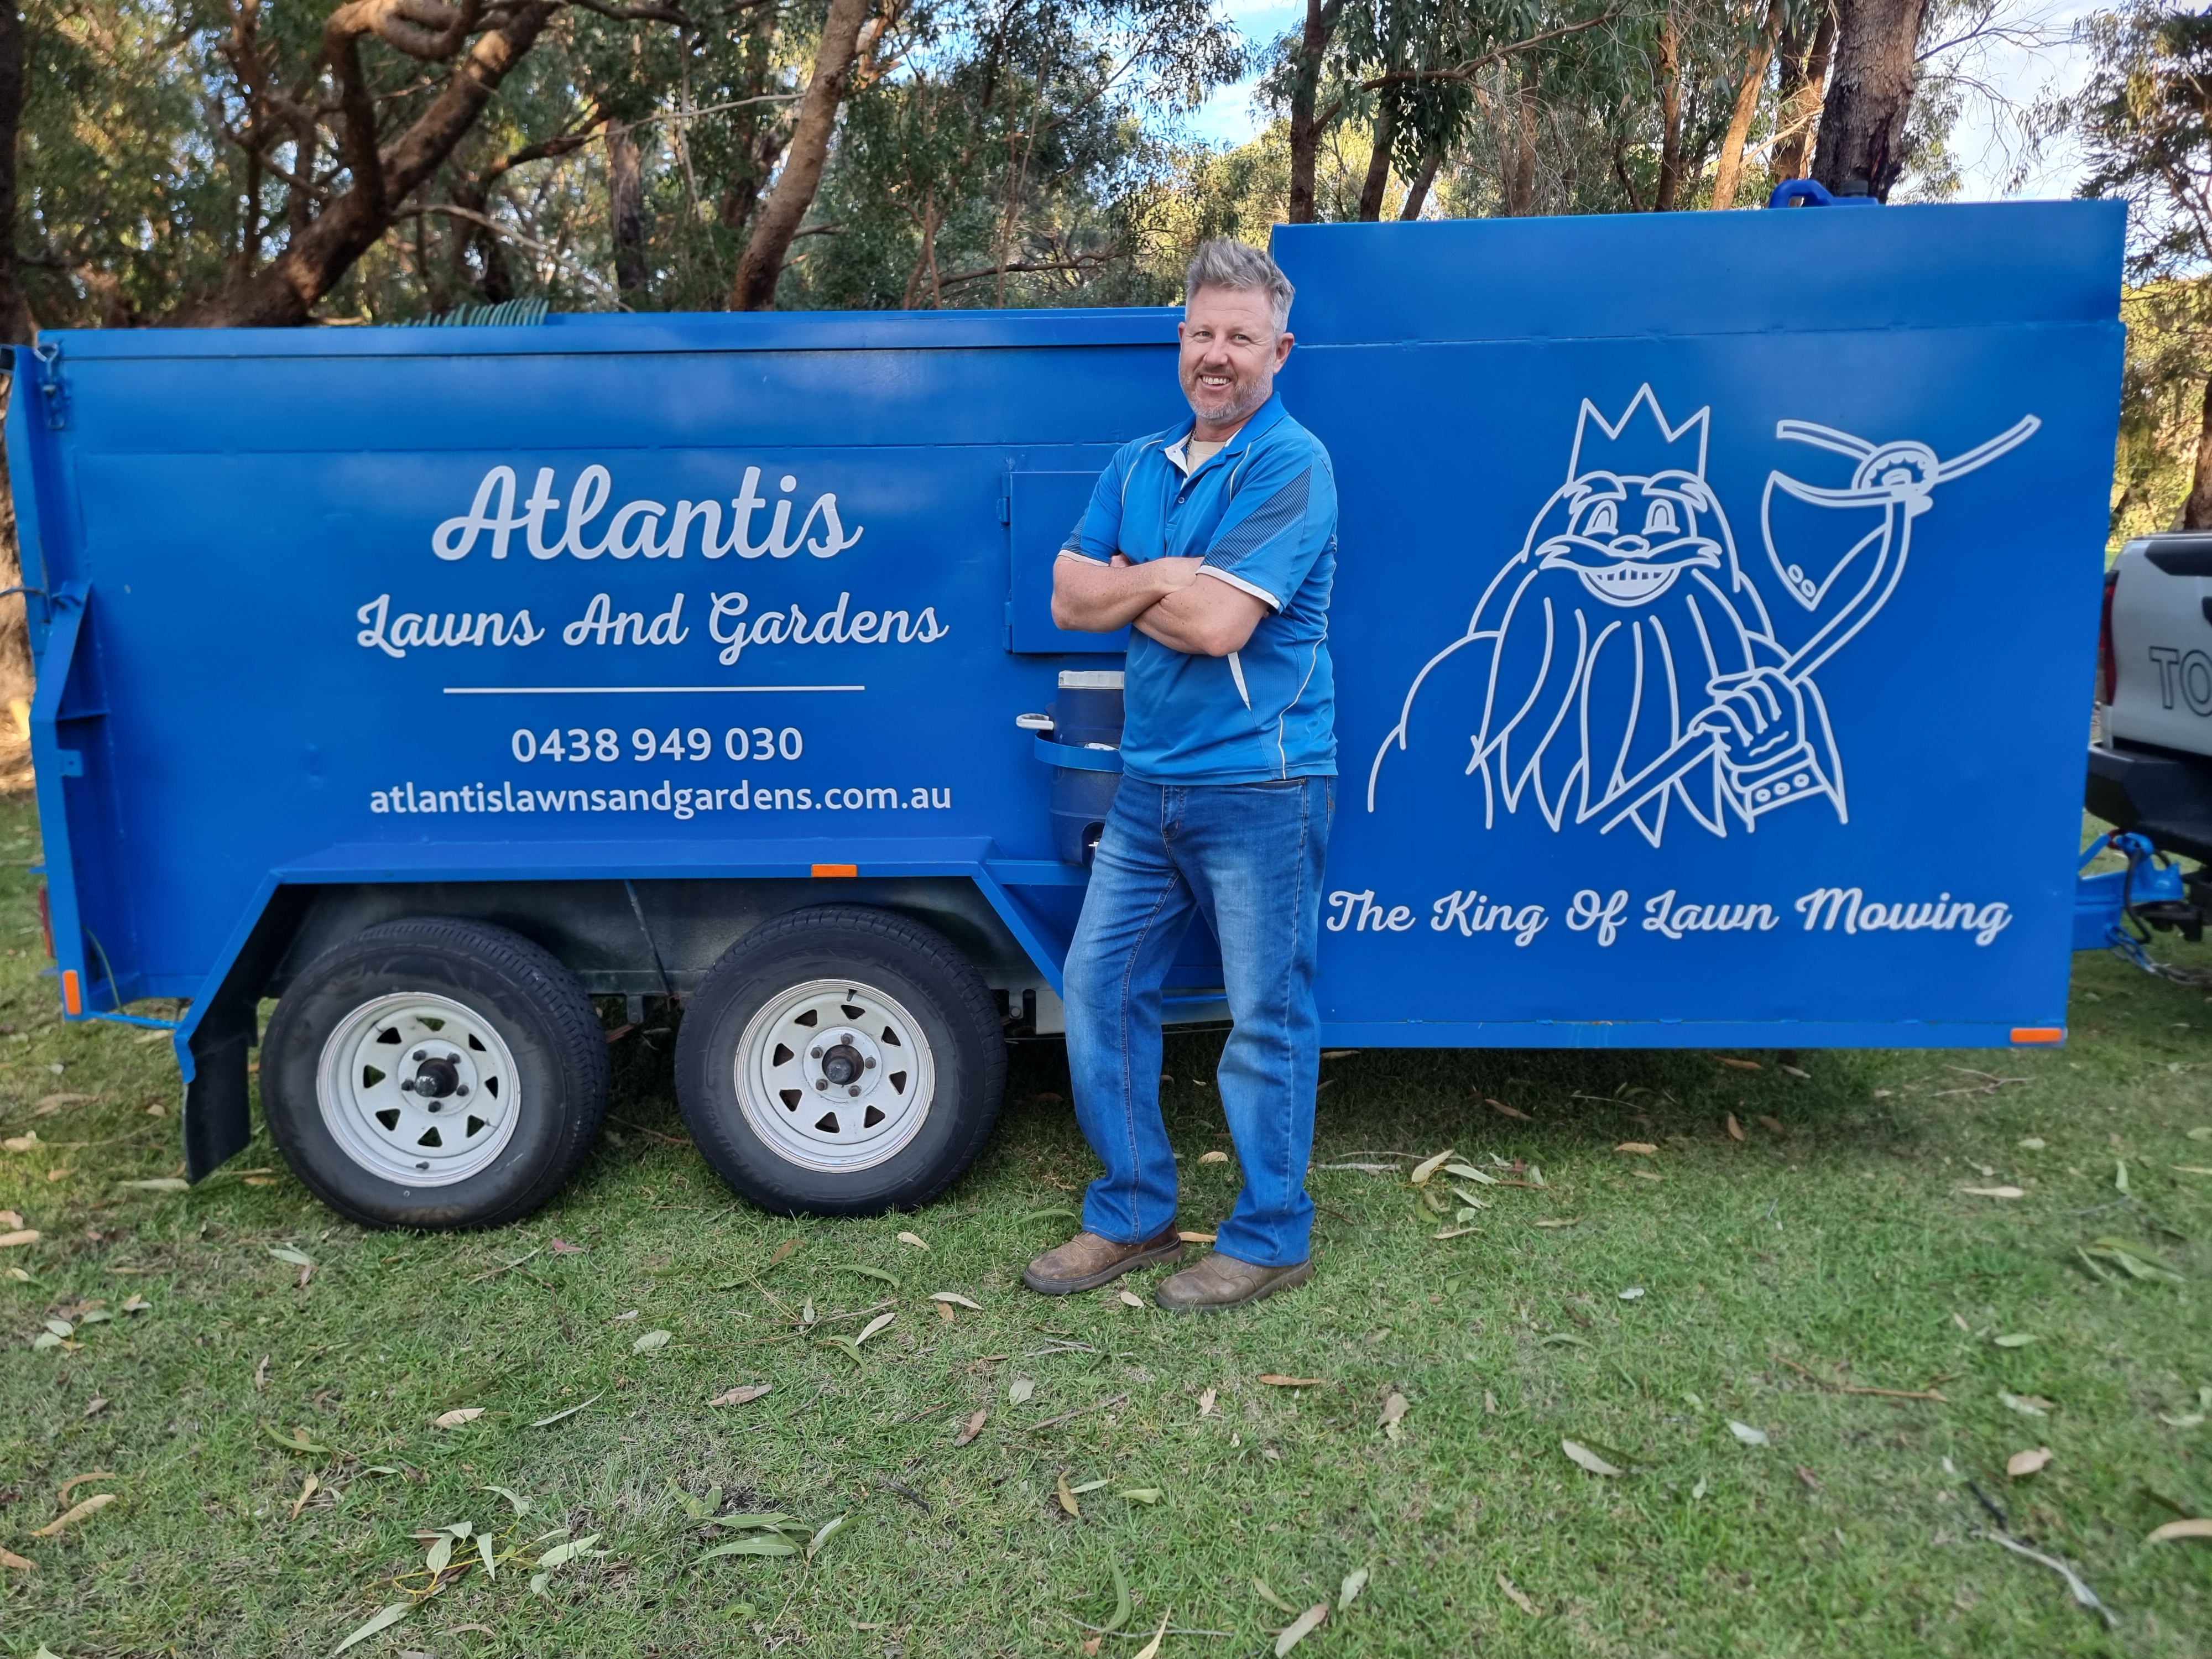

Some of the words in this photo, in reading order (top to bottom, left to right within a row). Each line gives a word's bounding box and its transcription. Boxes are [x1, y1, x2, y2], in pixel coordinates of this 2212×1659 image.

[432, 464, 864, 560] Atlantis
[357, 593, 545, 659] Lawns
[563, 593, 689, 646] And
[709, 591, 950, 666] Gardens
[512, 728, 620, 762] 0438
[632, 727, 712, 761] 949
[724, 727, 803, 761] 030
[370, 779, 951, 820] atlantislawnsandgardens.com.au
[1326, 889, 1416, 932] The
[1430, 890, 1550, 947] King
[1566, 889, 1629, 947] Of
[1642, 889, 1780, 940] Lawn
[1795, 887, 2013, 946] Mowing
